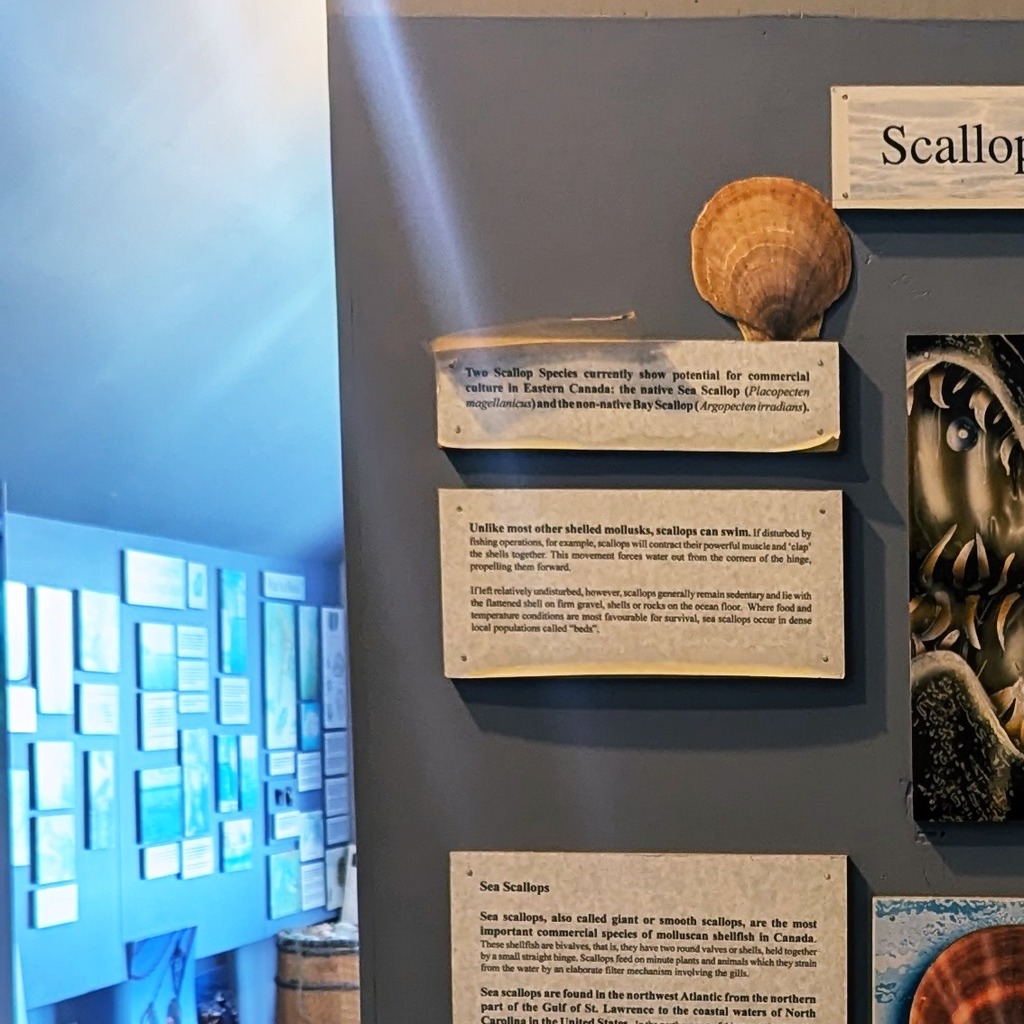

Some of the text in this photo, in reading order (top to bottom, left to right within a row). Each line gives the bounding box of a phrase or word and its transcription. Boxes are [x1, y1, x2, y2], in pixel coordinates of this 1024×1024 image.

[466, 367, 809, 382] Two Scallop Species currently show potential for commercial
[465, 383, 809, 399] culture in Eastern Canada: the native Sea Scallop (Placopecten
[465, 398, 536, 410] magellanicus)
[536, 399, 556, 408] and
[557, 399, 574, 408] the
[575, 399, 631, 409] non-native
[632, 400, 653, 412] Bay
[654, 400, 693, 412] Scallop
[469, 523, 811, 539] Unlike most other shelled mollusks, scallops can swim. If disturbed by
[469, 562, 570, 572] propelling them forward.
[479, 882, 549, 894] Sea Scallops
[480, 911, 817, 929] Sea scallops, also called giant or smooth scallops, are the most
[480, 926, 816, 943] important commercial species of molluscan shellfish in Canada.
[480, 963, 500, 971] from
[501, 963, 515, 972] the
[516, 964, 539, 972] water
[541, 964, 551, 975] by
[565, 965, 603, 974] elaborate
[605, 966, 625, 974] filter
[626, 966, 672, 975] mechanism
[674, 968, 713, 978] involving
[714, 969, 727, 977] the
[729, 969, 749, 979] gills.
